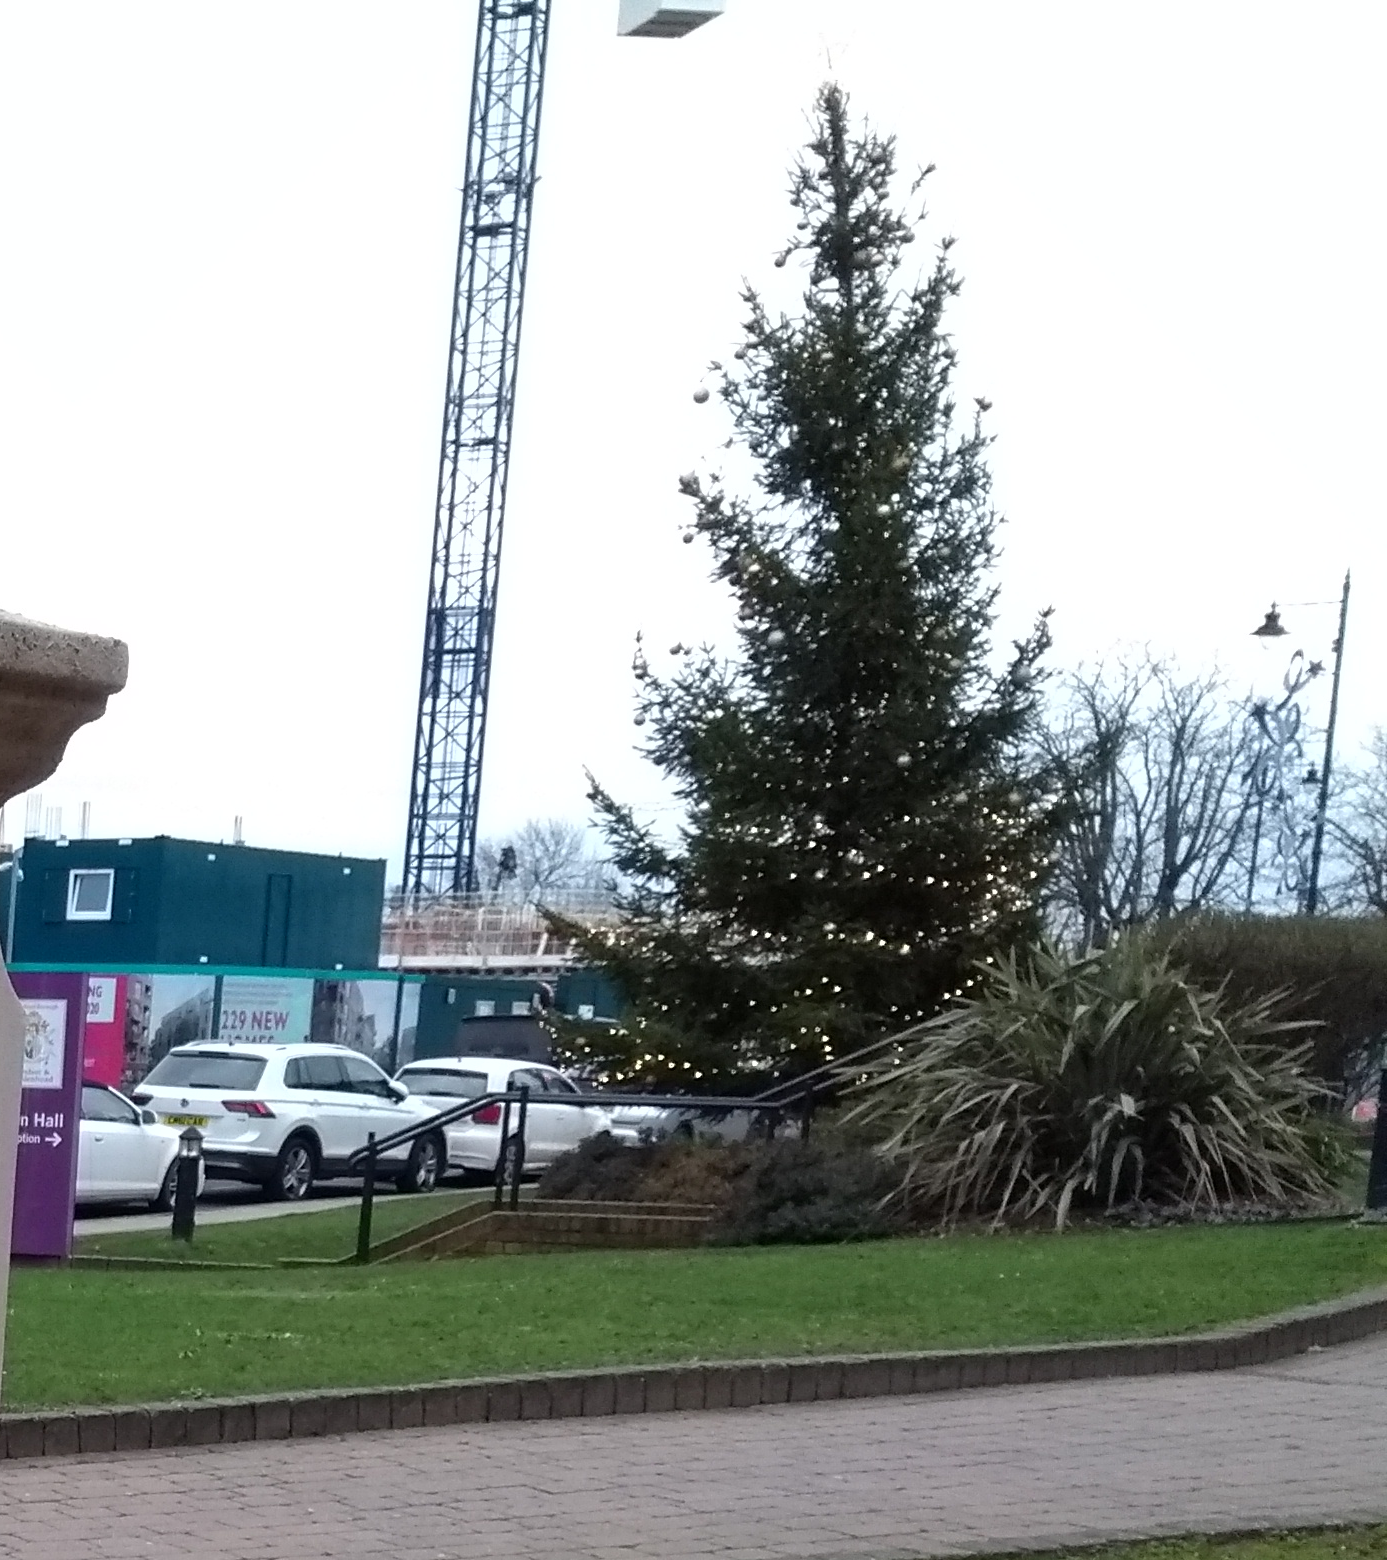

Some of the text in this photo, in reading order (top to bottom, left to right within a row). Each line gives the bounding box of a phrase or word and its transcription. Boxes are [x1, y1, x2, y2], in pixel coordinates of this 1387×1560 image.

[221, 1010, 290, 1031] 229 NEW
[34, 1112, 64, 1128] Hall
